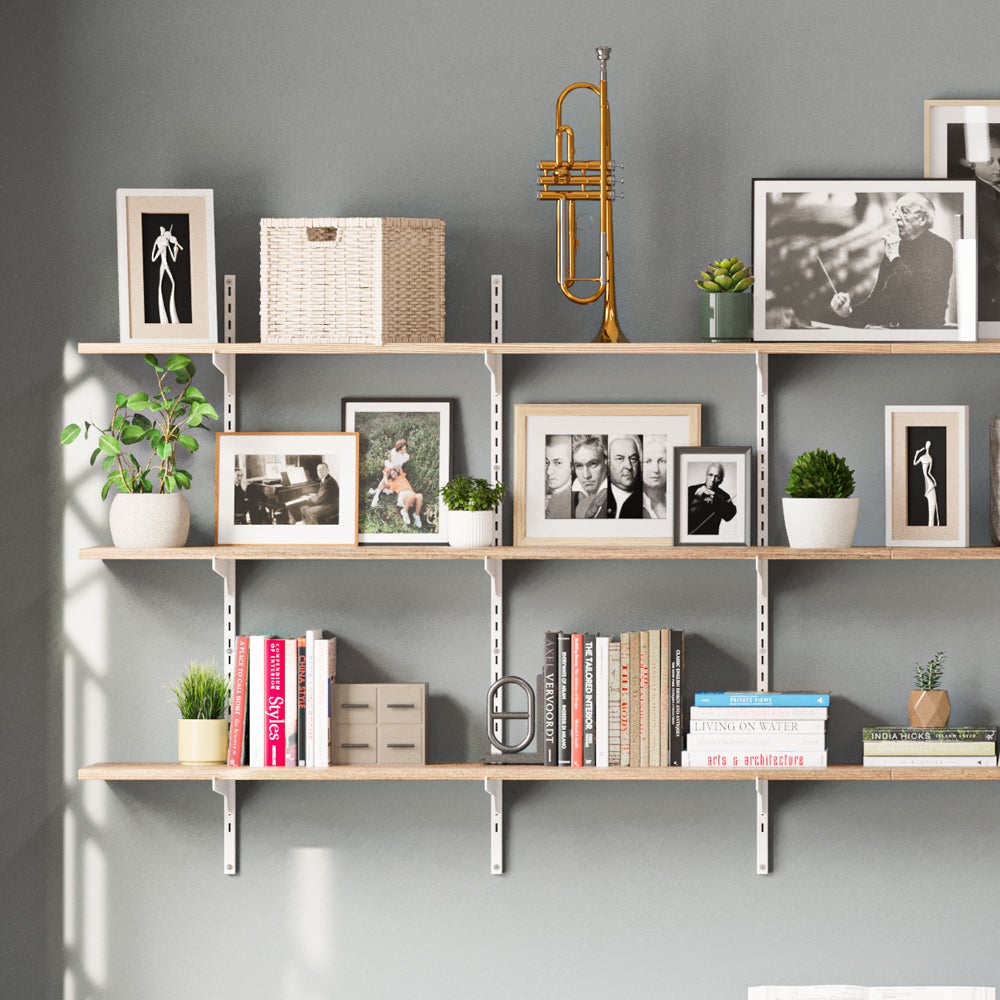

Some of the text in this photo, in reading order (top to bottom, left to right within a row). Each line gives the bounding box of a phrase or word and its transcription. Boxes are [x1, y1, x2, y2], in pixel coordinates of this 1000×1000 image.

[270, 643, 275, 652] OF
[585, 642, 593, 656] THE
[585, 658, 593, 694] TAILORED
[546, 673, 554, 744] VERVOORDT
[585, 694, 593, 730] INTERIOR
[265, 696, 285, 741] Styles
[695, 722, 799, 732] LIVING ON WATER
[871, 732, 931, 740] INDIA HICKS
[707, 754, 727, 766] arts
[744, 754, 804, 766] architecture
